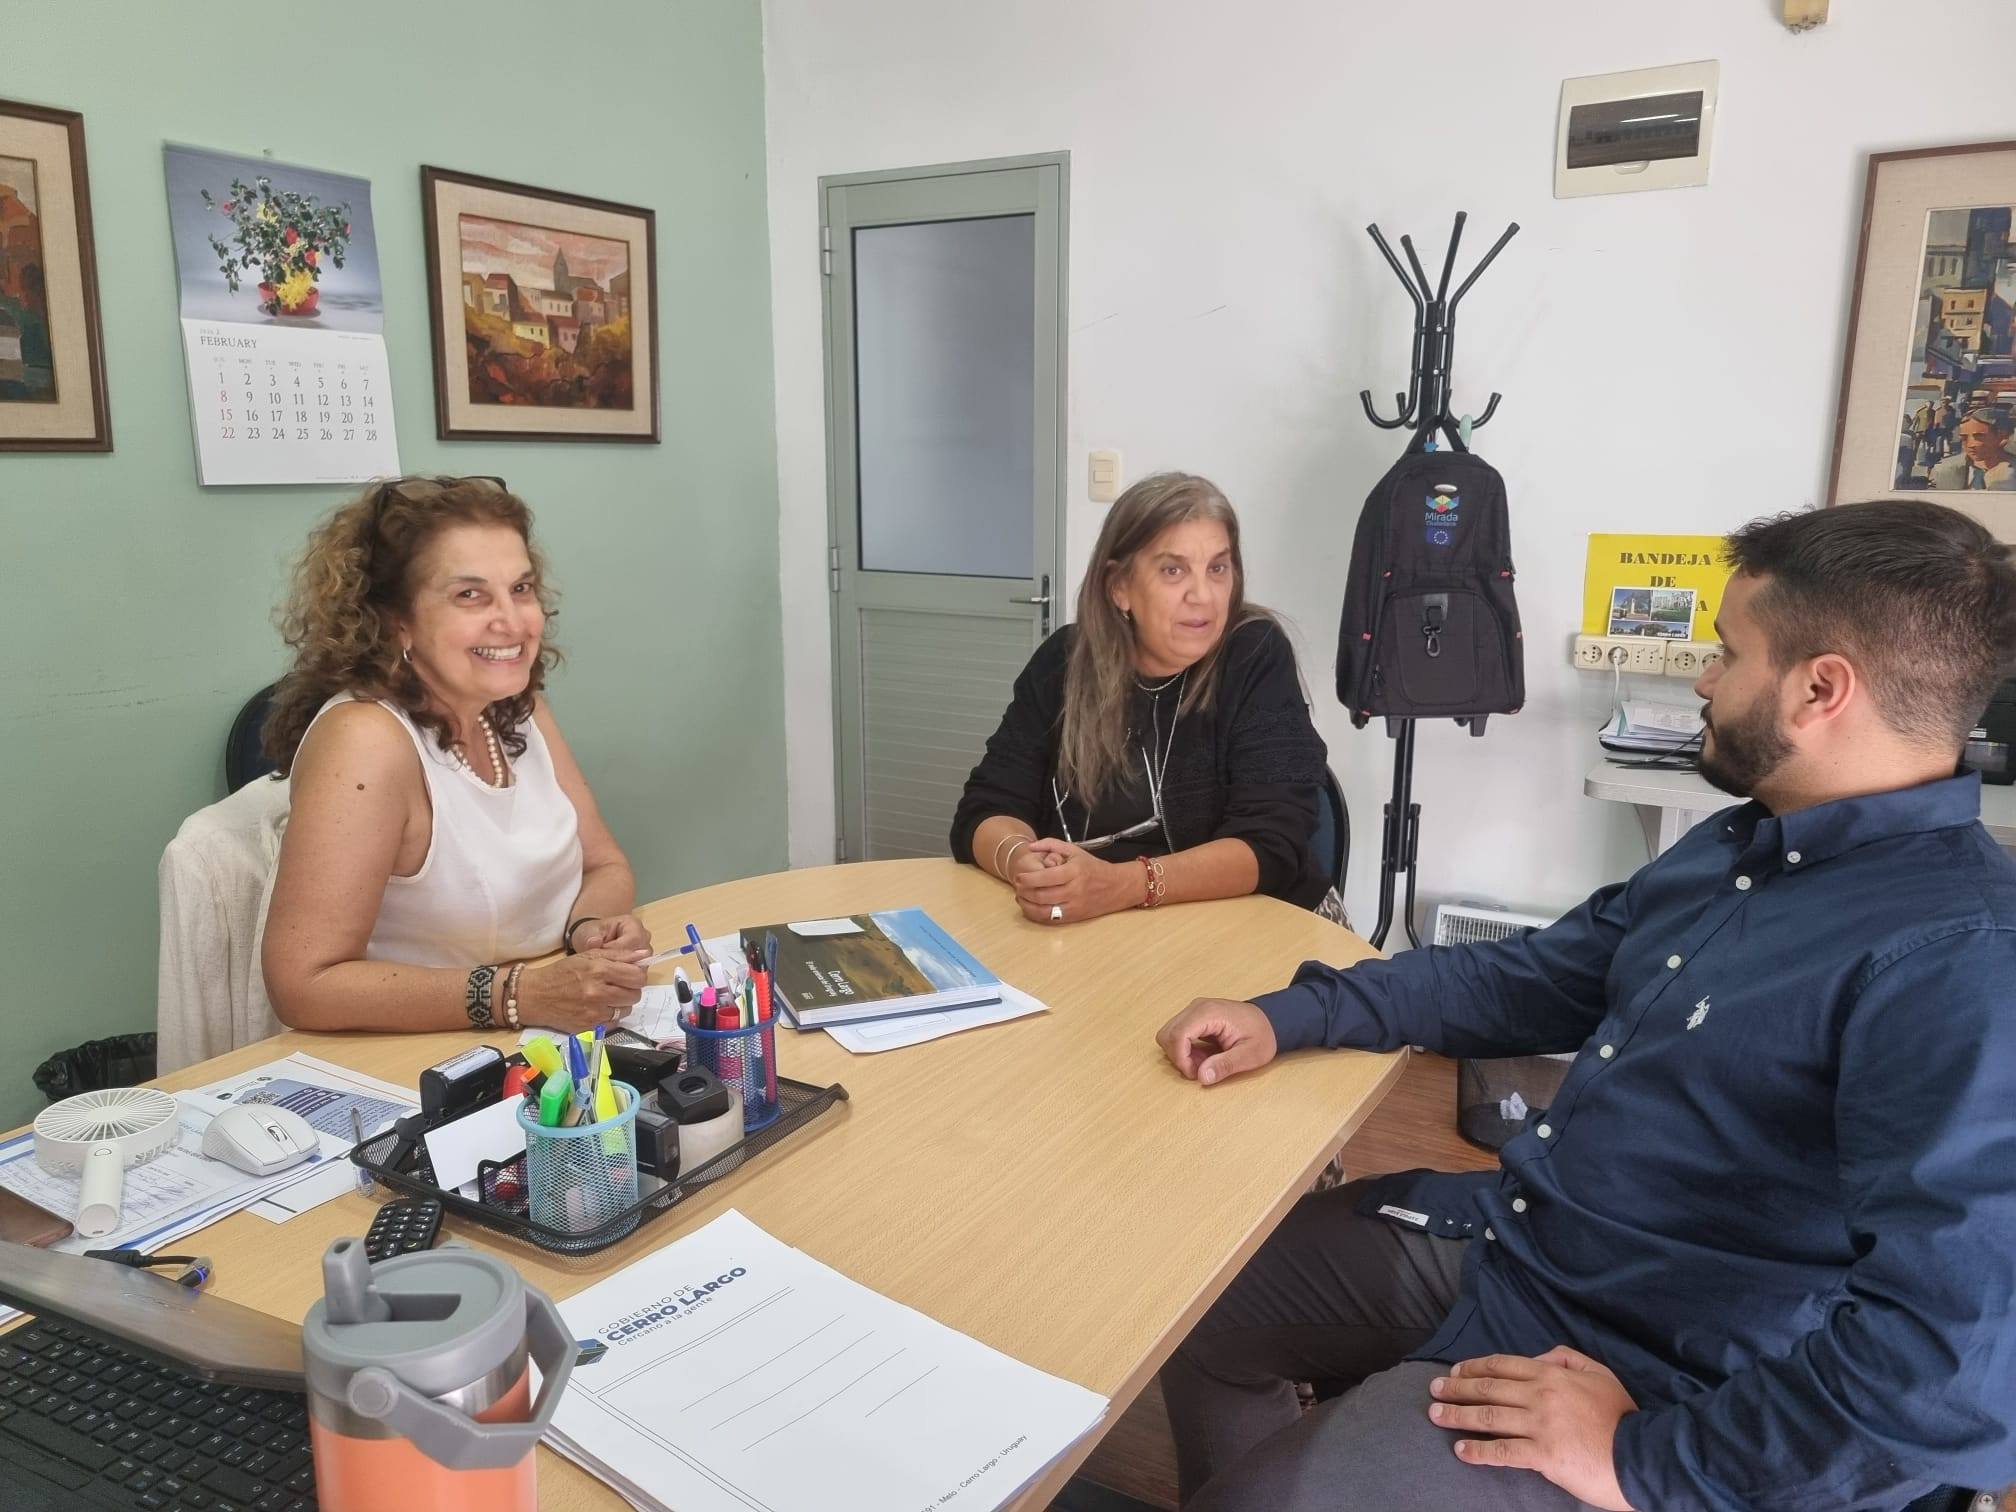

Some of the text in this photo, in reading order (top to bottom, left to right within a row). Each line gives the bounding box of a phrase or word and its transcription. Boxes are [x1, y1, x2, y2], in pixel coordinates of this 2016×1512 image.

[200, 335, 257, 349] FEBRUARY
[219, 371, 369, 391] 1 2 3 4 5 6 7
[220, 390, 373, 408] 8 9 10 11 12 13 14
[221, 408, 374, 424] 15 16 17 18 19 20 21
[222, 426, 377, 441] 22 23 24 25 26 27 28
[1425, 512, 1458, 522] Mirada
[1620, 552, 1711, 566] BANDEJA
[1650, 575, 1676, 588] DE
[827, 970, 854, 995] Cerro Largo
[598, 1284, 695, 1335] GOBIERNO DE
[606, 1267, 747, 1341] CERRO LARGO
[618, 1322, 664, 1346] Cercano
[671, 1312, 683, 1322] la
[684, 1296, 713, 1316] gente
[960, 1472, 980, 1488] Cerro
[977, 1457, 998, 1475] Largo
[1000, 1434, 1028, 1457] Uruguay
